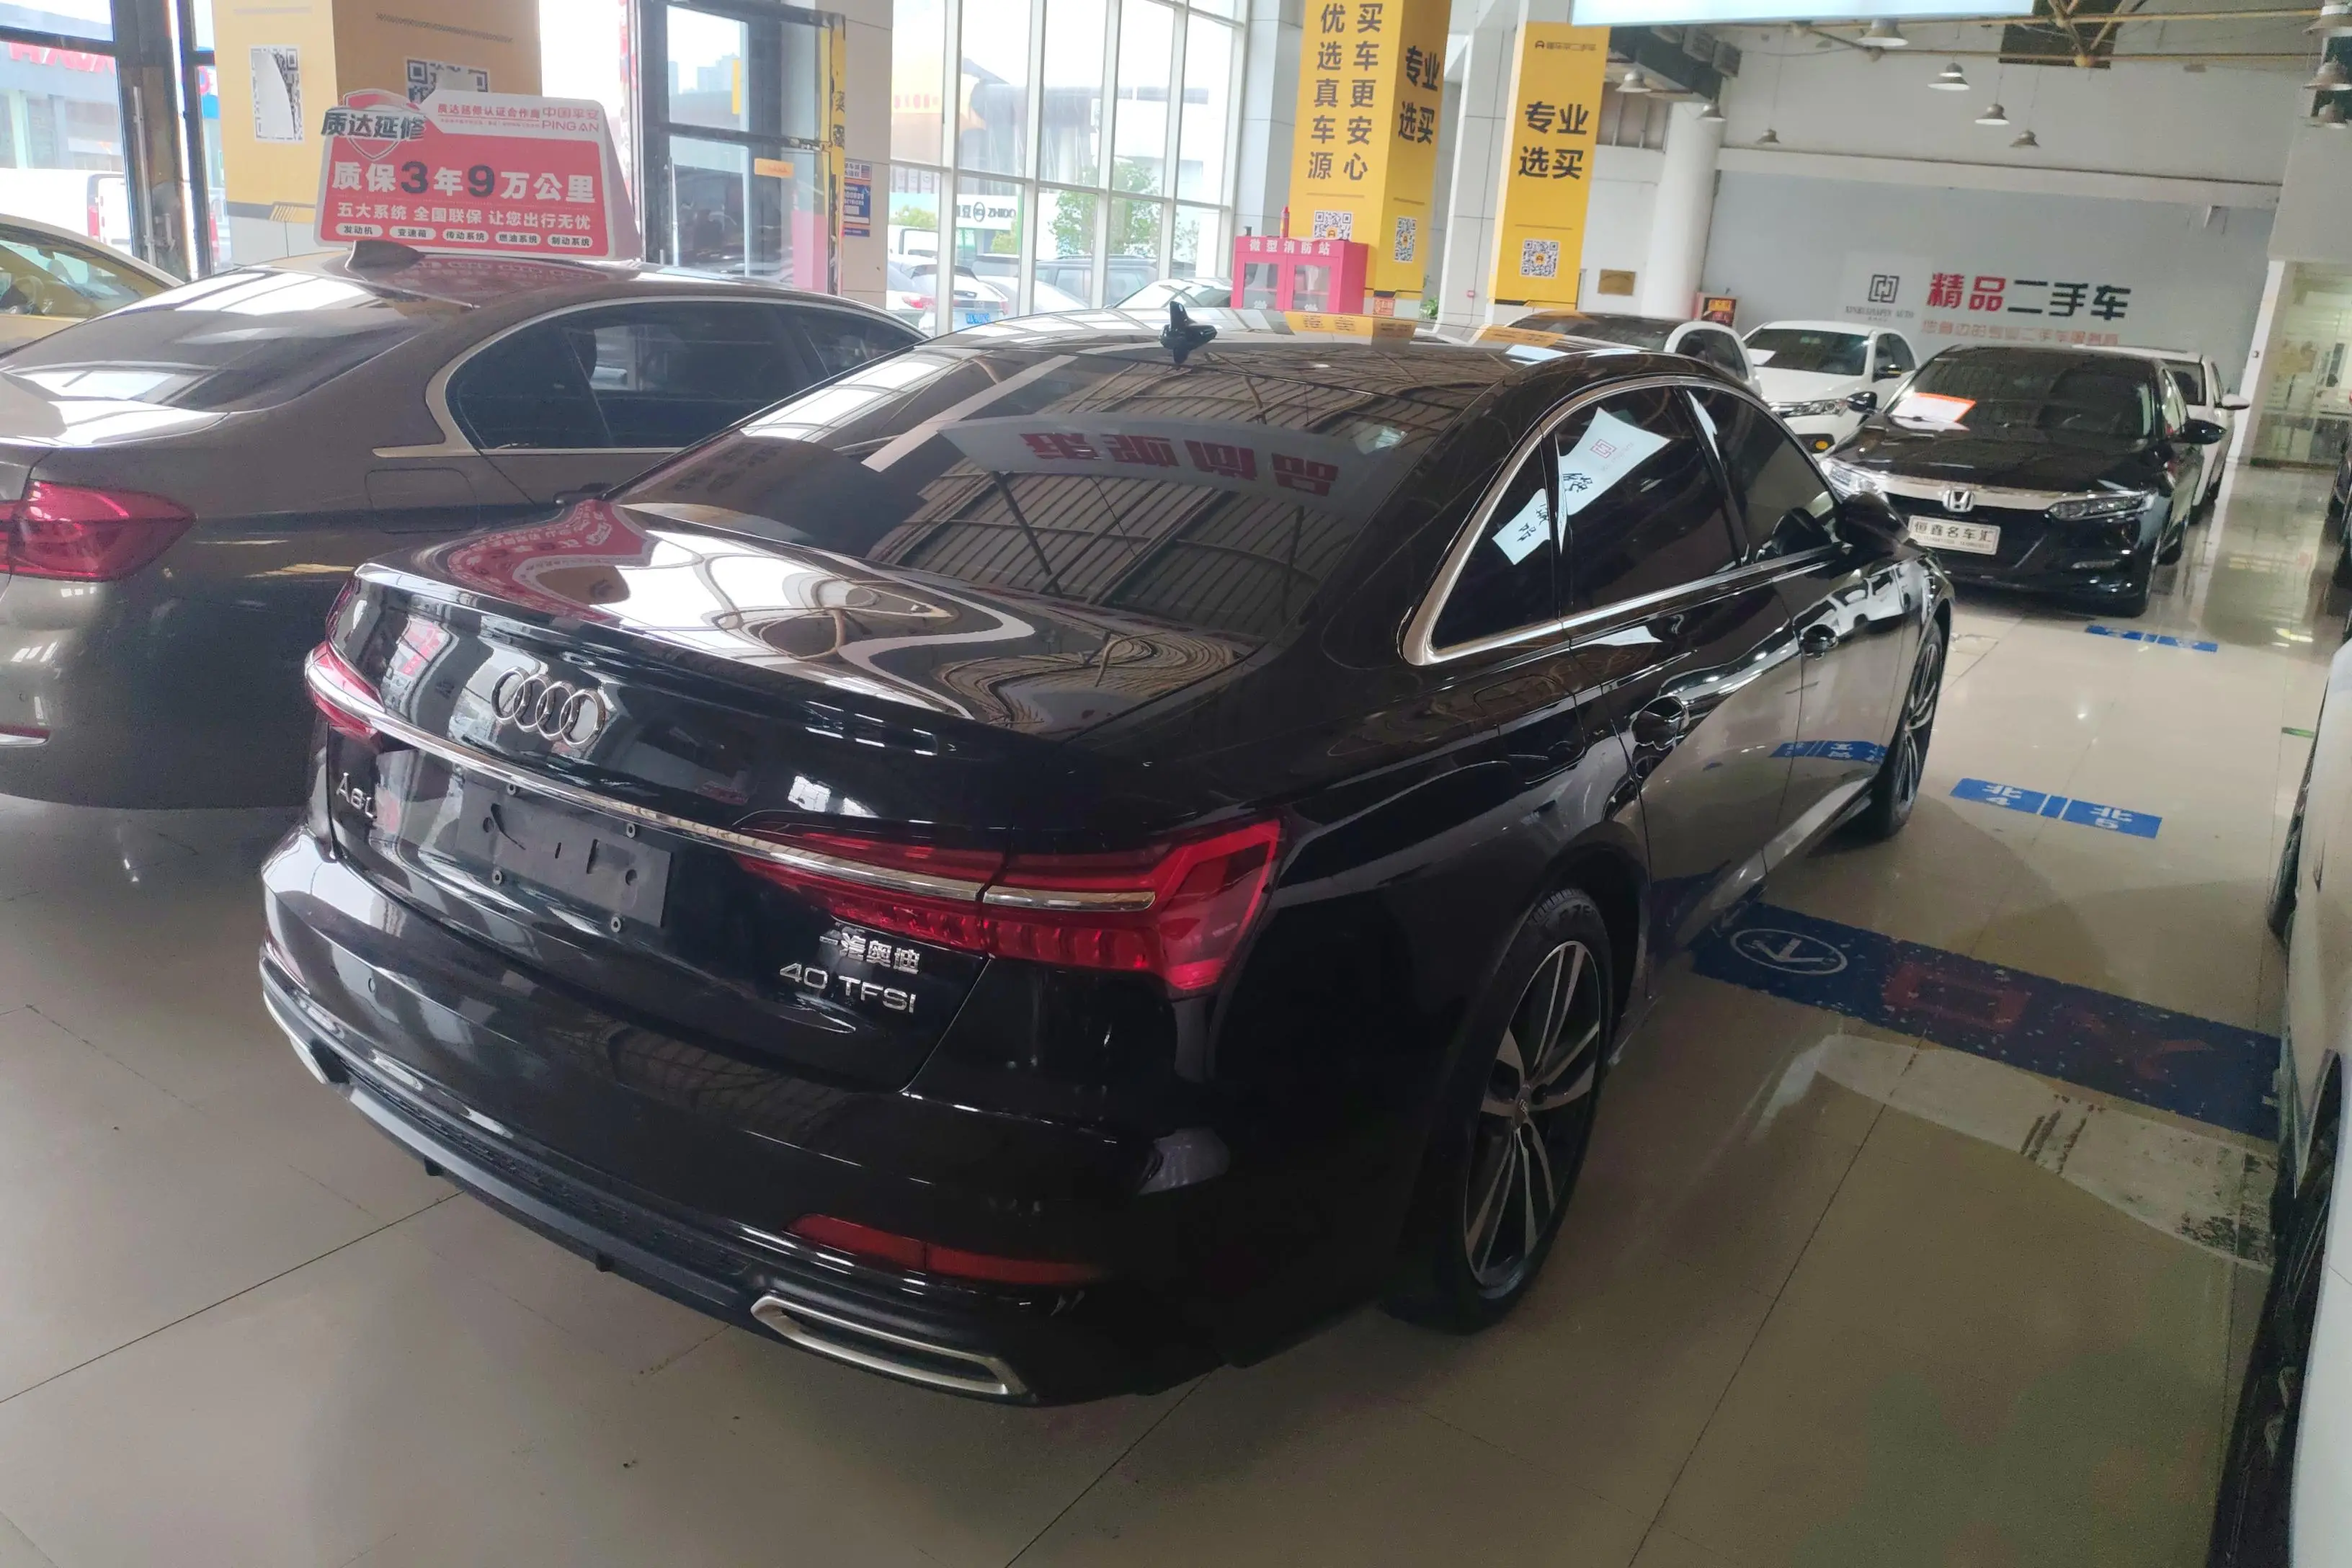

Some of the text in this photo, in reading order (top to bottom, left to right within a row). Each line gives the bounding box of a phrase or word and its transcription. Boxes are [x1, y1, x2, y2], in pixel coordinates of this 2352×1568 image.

[1405, 45, 1440, 92] 专业
[1306, 3, 1346, 180] 优选真车源
[1342, 3, 1384, 181] 买车更安心
[320, 110, 427, 140] 质达延修
[542, 106, 600, 120] 中国平安
[1397, 100, 1435, 146] 选买
[1525, 101, 1589, 135] 专业
[1518, 146, 1584, 180] 选买
[331, 160, 597, 204] 质保3年9万公里
[337, 202, 591, 231] 五大系统 全国联保 让您出行无忧
[343, 225, 373, 236] 发动机
[396, 227, 428, 239] 变速箱
[445, 229, 486, 242] 传动系统
[498, 233, 539, 245] 燃油系统
[550, 235, 591, 247] 制动系统
[1249, 239, 1330, 256] 微型消防站
[1926, 272, 2132, 321] 精品二手车
[779, 962, 917, 1013] 40 TFSI
